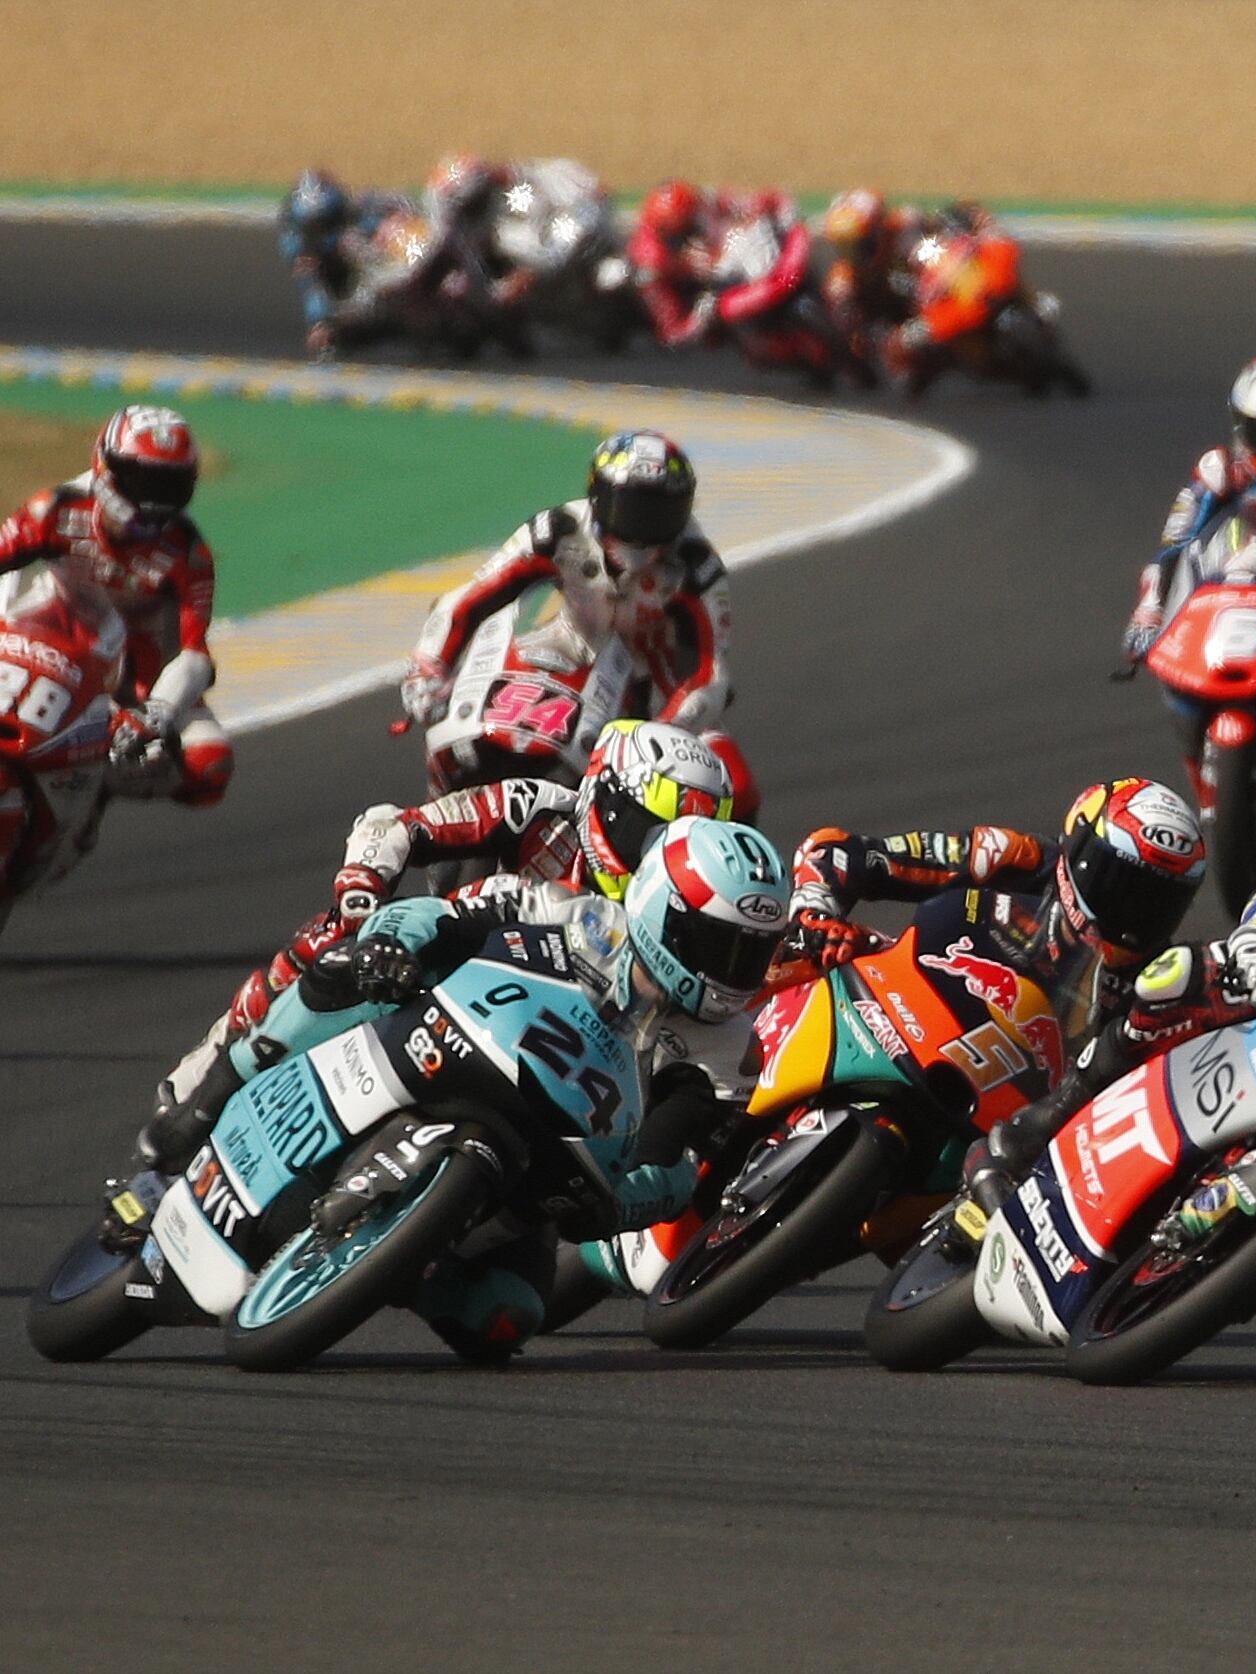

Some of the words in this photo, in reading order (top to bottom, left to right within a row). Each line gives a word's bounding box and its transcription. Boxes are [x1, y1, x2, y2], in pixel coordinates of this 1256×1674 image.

[484, 682, 577, 736] 54
[747, 898, 779, 916] Arai
[423, 1006, 473, 1059] DOVIT
[517, 1005, 623, 1137] 24
[938, 1021, 1028, 1091] 5
[250, 1061, 327, 1176] LEOPARD
[1092, 1064, 1174, 1164] MT
[186, 1145, 246, 1237] DOVIT
[1076, 1125, 1104, 1196] HELMETS
[1017, 1176, 1075, 1283] SEVENTY
